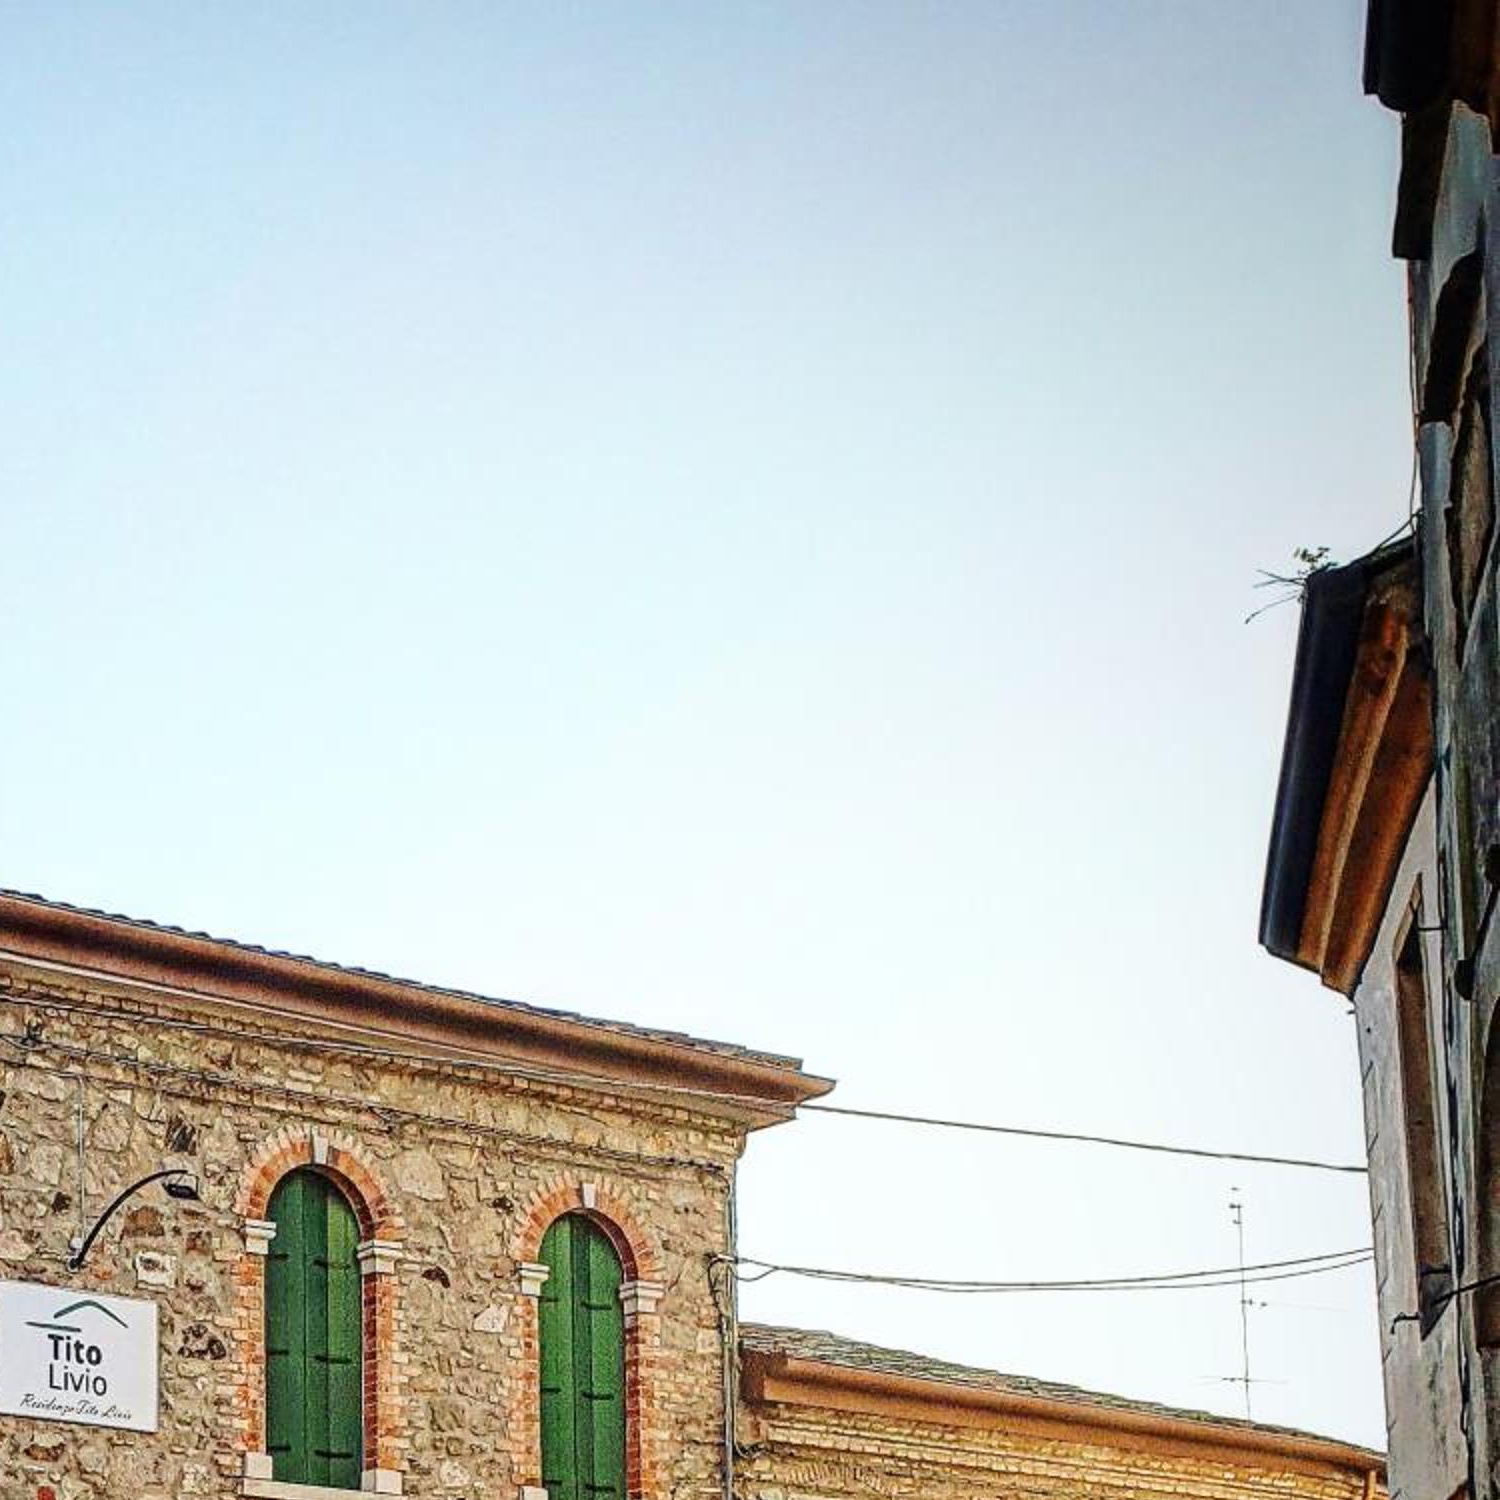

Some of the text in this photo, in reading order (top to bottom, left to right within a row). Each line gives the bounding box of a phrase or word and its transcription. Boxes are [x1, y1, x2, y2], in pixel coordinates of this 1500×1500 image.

[47, 1333, 102, 1366] Tito
[49, 1363, 107, 1396] Livio
[76, 1400, 99, 1415] Tito
